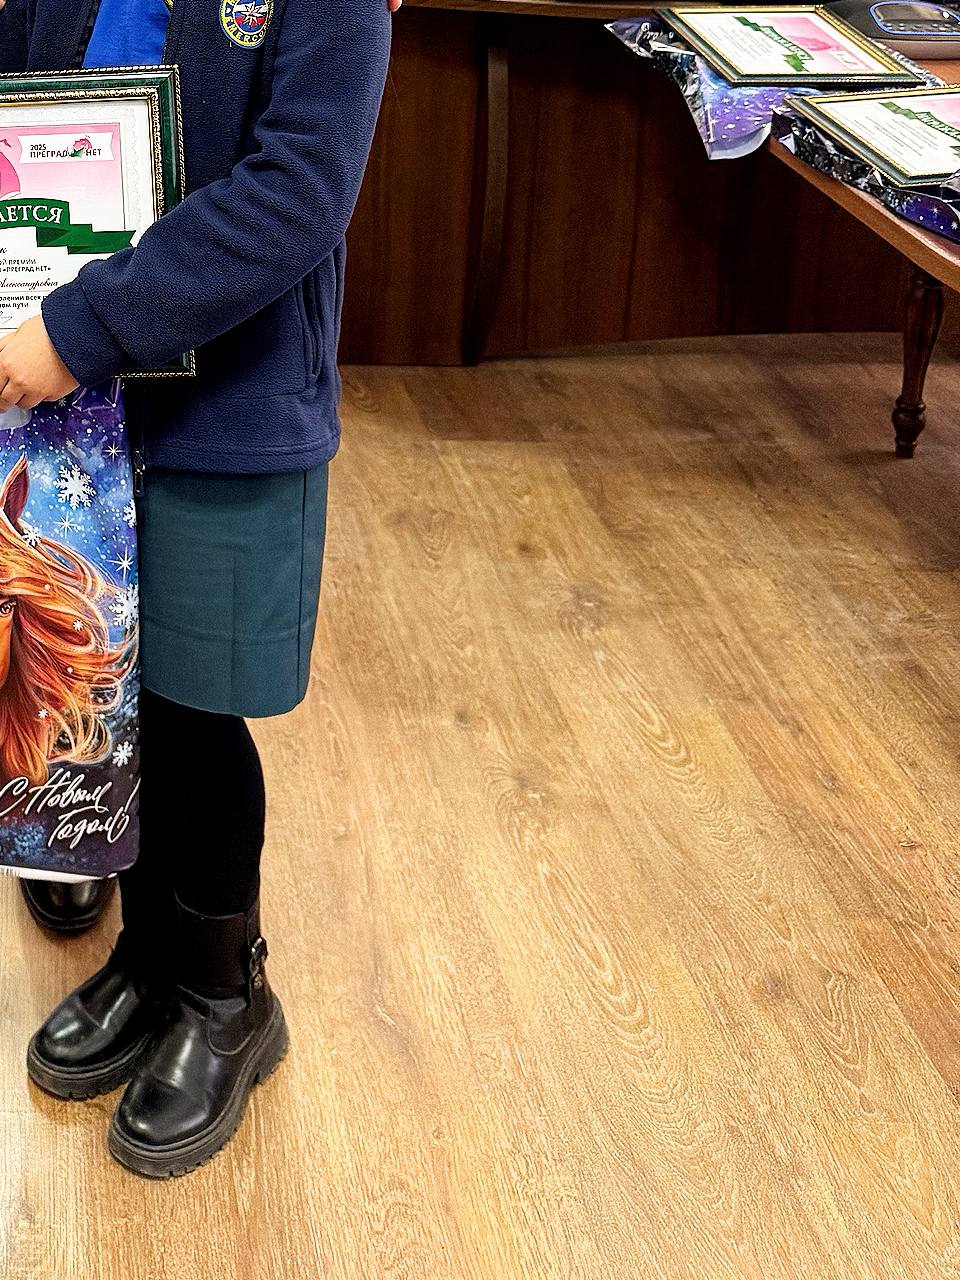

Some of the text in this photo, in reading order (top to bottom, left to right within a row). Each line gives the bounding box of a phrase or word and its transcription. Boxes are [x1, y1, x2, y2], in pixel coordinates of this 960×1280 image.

[30, 148, 102, 158] ПРЕГРАД НЕТ
[8, 258, 37, 266] ПРЕМИИ
[24, 767, 113, 816] Новым
